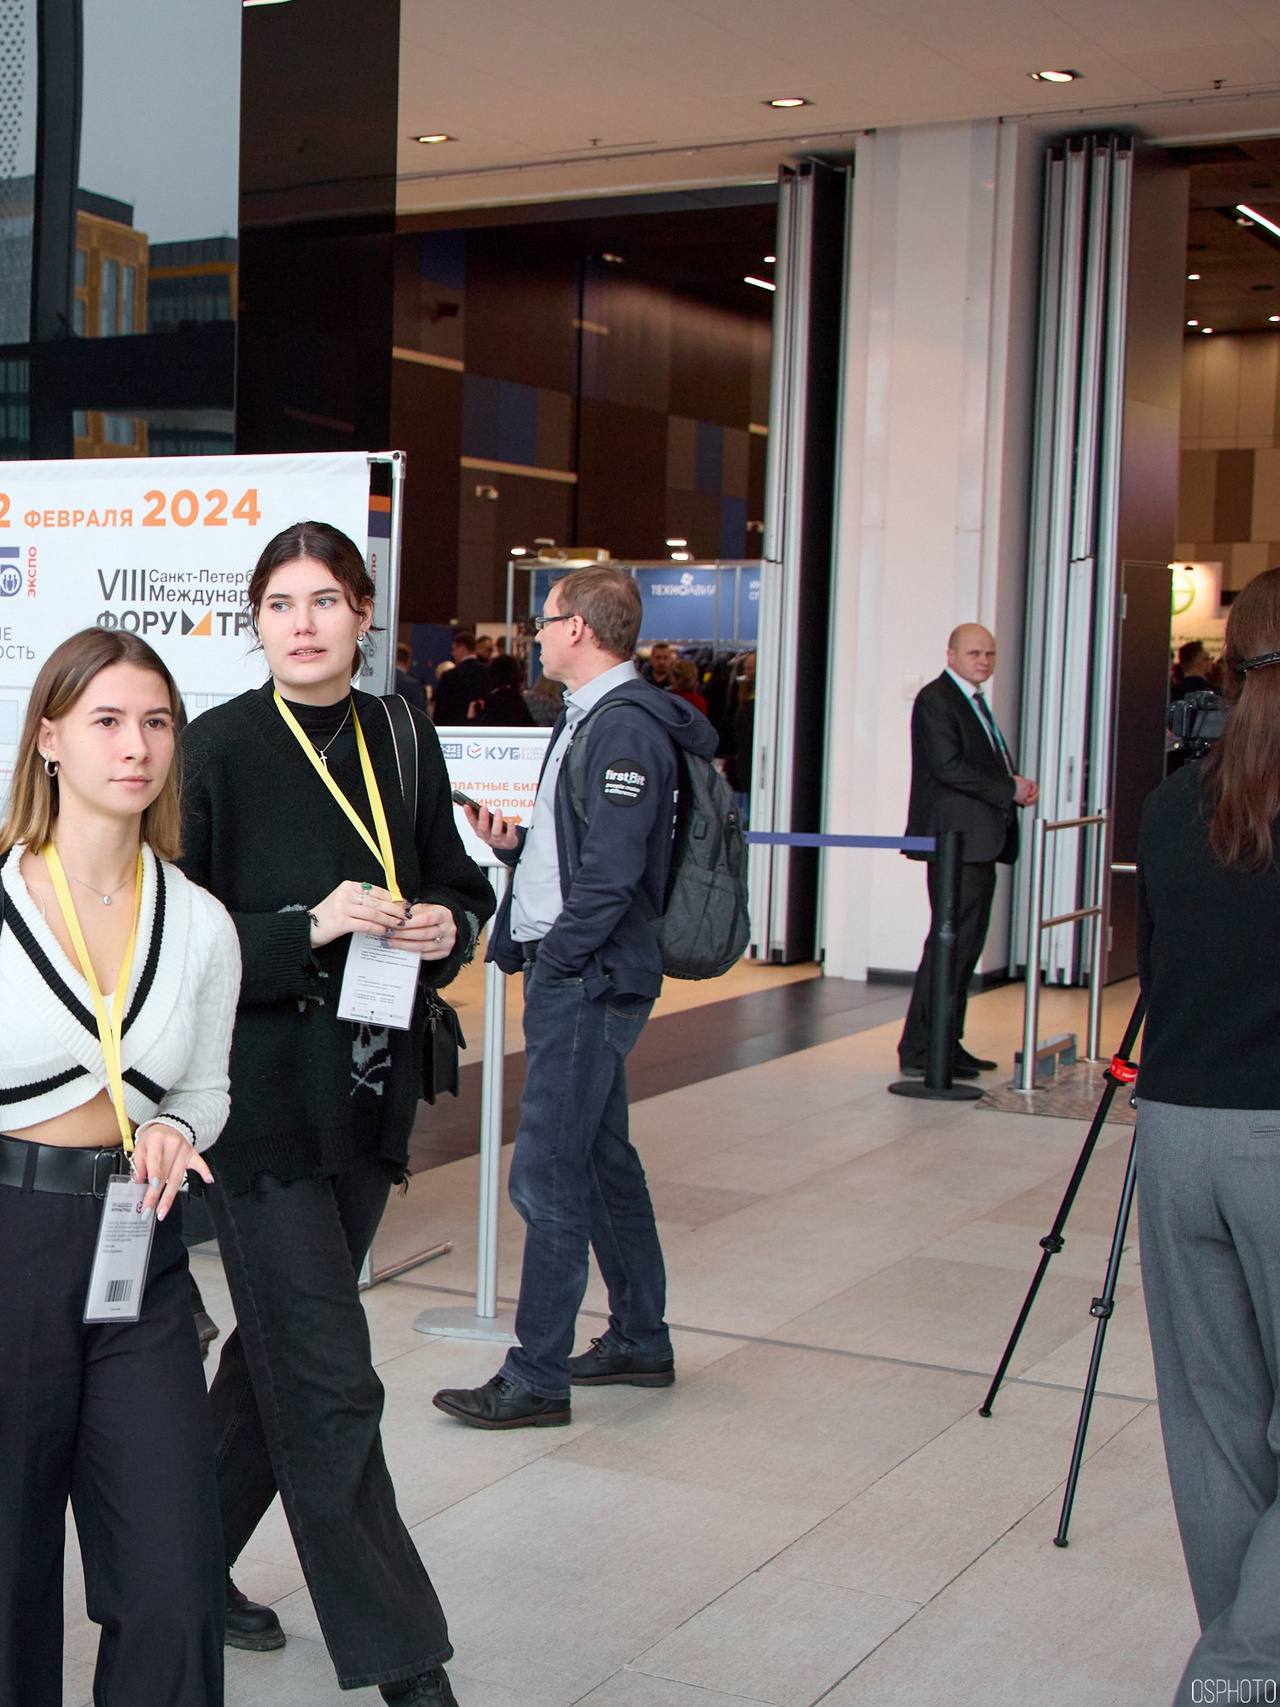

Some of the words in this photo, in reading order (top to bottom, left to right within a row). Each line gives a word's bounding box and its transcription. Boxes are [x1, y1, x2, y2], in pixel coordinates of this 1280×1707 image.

[23, 509, 133, 528] ФЕВРАЛЯ
[142, 488, 261, 527] 2024
[27, 546, 37, 597] ЭКСПО
[149, 569, 254, 585] Санкт-Петерб
[97, 569, 146, 601] VIII
[149, 585, 250, 605] Междунар
[216, 611, 252, 636] ТР
[485, 747, 521, 760] КУБ
[451, 781, 510, 792] ПЛАТНЫЕ
[513, 782, 539, 792] БИЛ
[474, 798, 535, 808] ИНОПОКА
